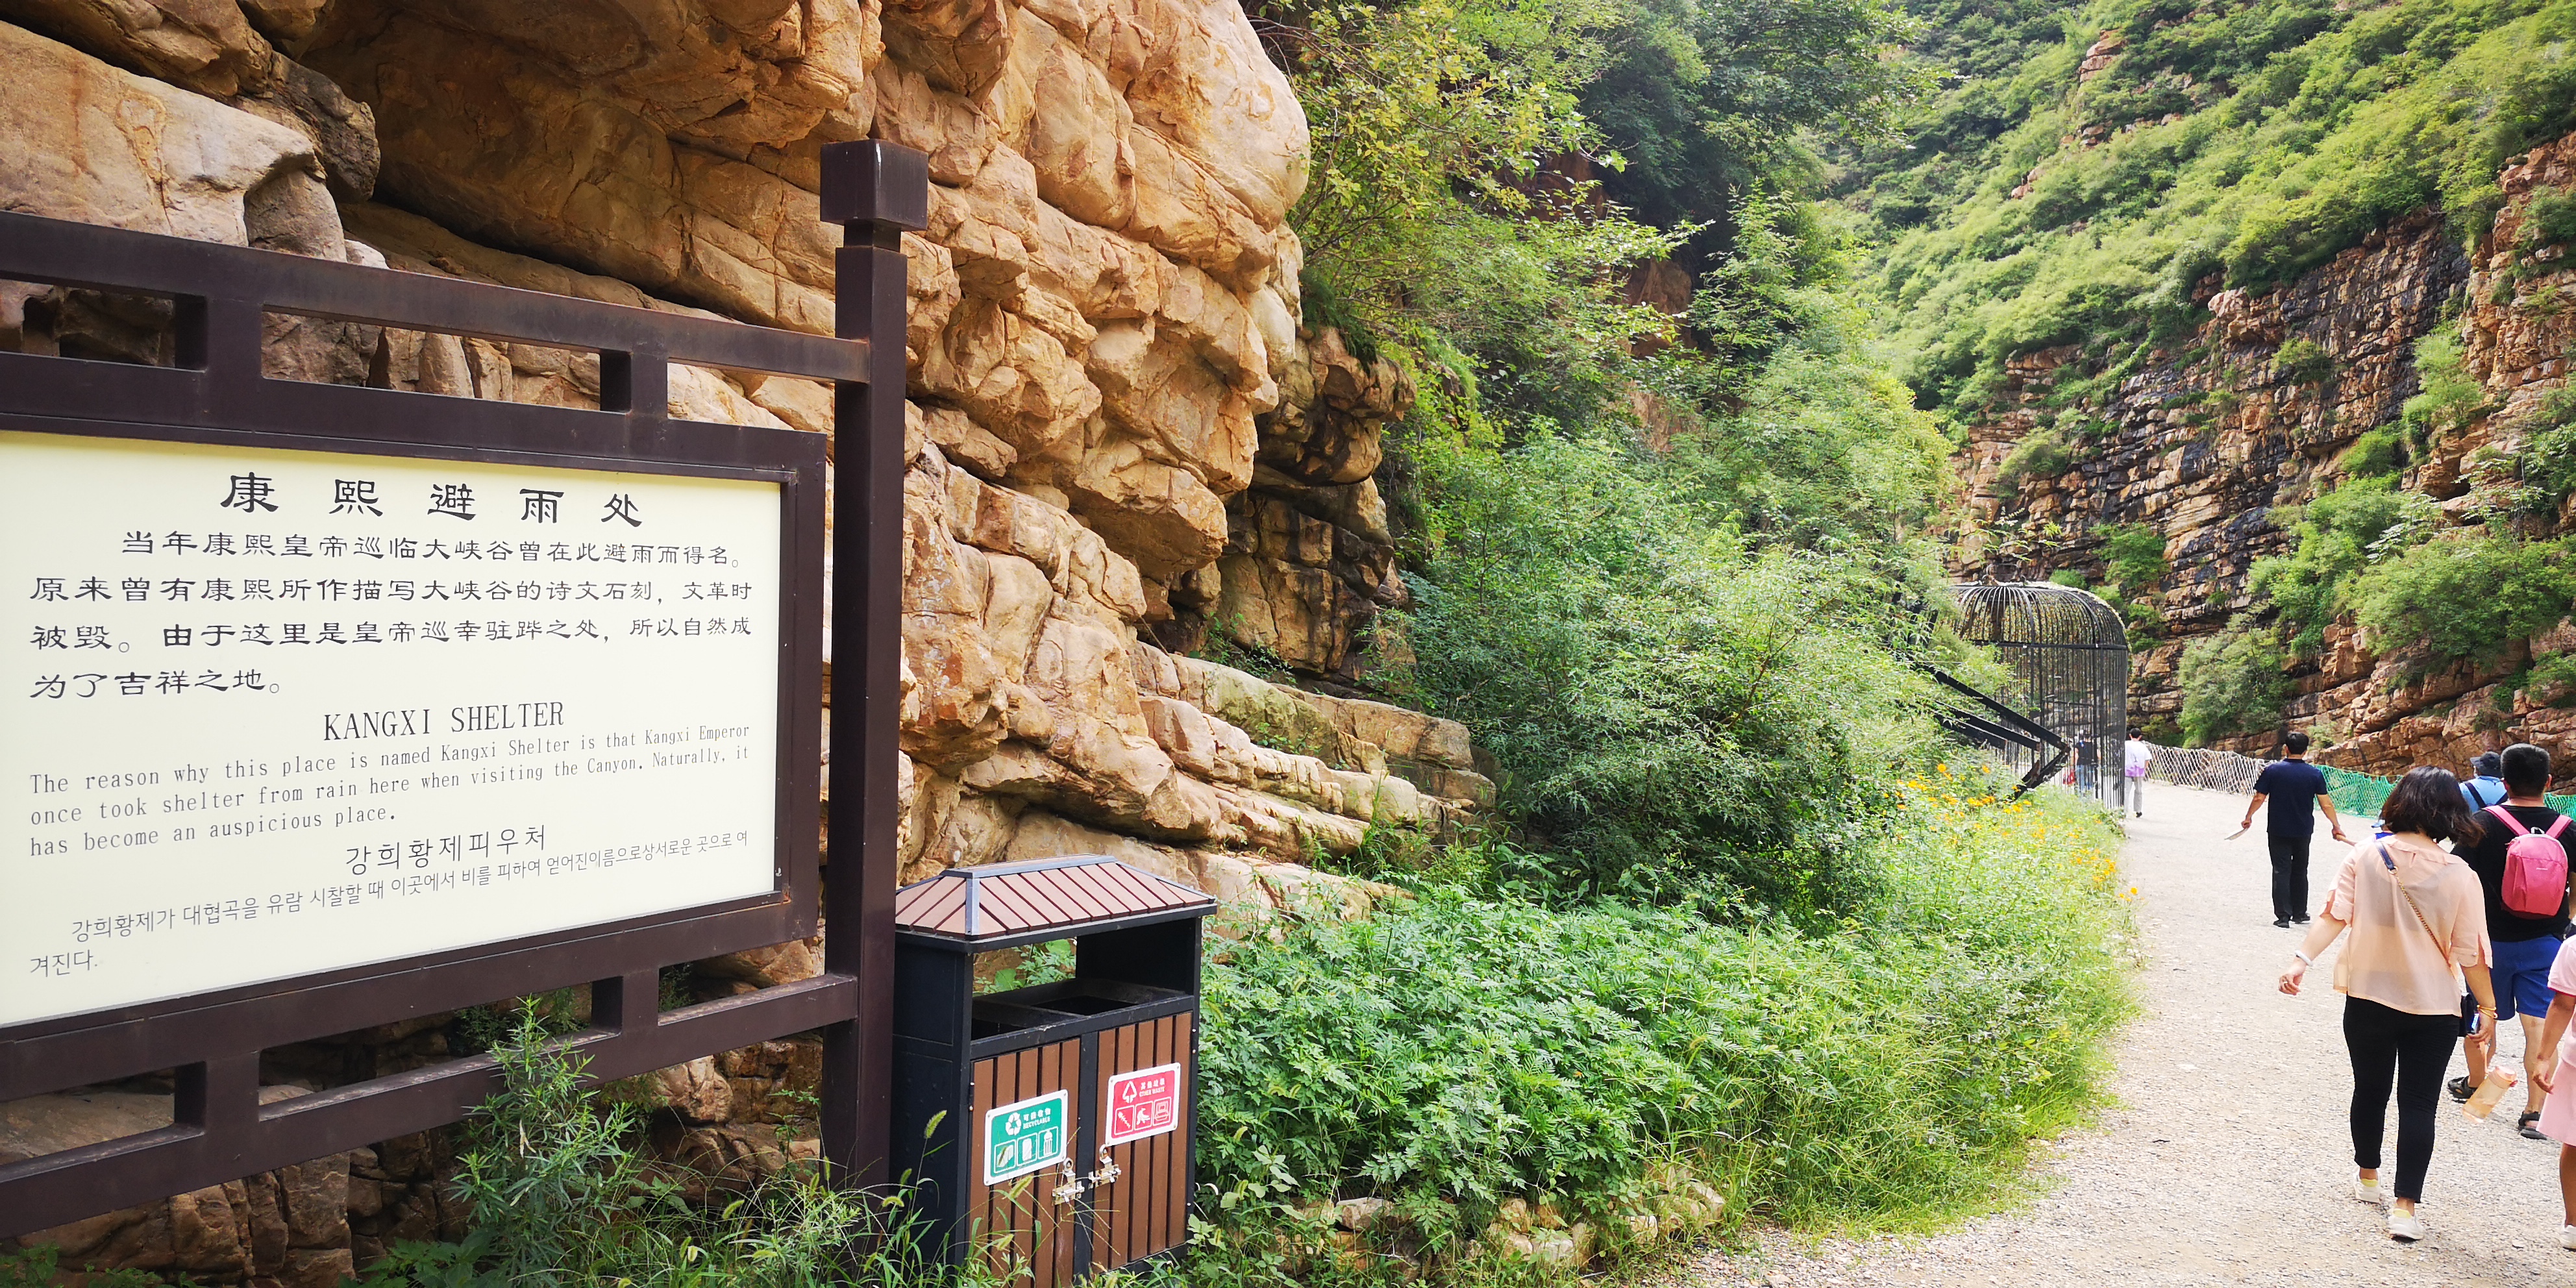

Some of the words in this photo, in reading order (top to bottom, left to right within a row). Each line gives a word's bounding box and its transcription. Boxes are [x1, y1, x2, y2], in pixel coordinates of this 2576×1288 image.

[219, 471, 643, 528] 康熙避雨处
[323, 708, 430, 741] KANGXI
[451, 701, 564, 733] SHELTER
[30, 774, 69, 794] The
[85, 772, 159, 789] reason
[173, 763, 209, 784] why
[225, 758, 268, 779] this
[282, 755, 336, 777] place
[351, 751, 367, 769] is
[381, 746, 430, 766] named
[441, 741, 495, 762] Kangxi
[508, 737, 570, 756] Shelter
[581, 734, 595, 750] is
[606, 732, 636, 748] that
[645, 726, 689, 745] Kangxi
[699, 725, 749, 741] Emperor
[31, 808, 82, 825] once
[99, 797, 147, 819] took
[163, 791, 245, 813] shelter
[258, 786, 303, 804] from
[316, 780, 357, 799] rain
[369, 777, 410, 794] here
[421, 771, 459, 789] when
[471, 764, 543, 784] visiting
[554, 760, 578, 776] the
[588, 758, 643, 774] Canyon.
[652, 747, 725, 767] Naturally,
[737, 745, 748, 760] it
[31, 837, 68, 856] has
[84, 830, 158, 850] become
[173, 827, 195, 841] an
[210, 812, 322, 838] auspicious
[335, 806, 395, 828] place.
[345, 824, 545, 876] 강희황제피우처
[71, 908, 176, 943] 강희황제가
[183, 897, 260, 926] 대협곡을
[266, 891, 304, 915] 유람
[368, 880, 384, 899] 때
[391, 870, 454, 897] 이곳에서
[462, 865, 492, 886] 비를
[497, 858, 540, 881] 피하여
[697, 833, 732, 853] 곳으로
[736, 830, 747, 847] 여
[30, 949, 98, 978] 겨진다.
